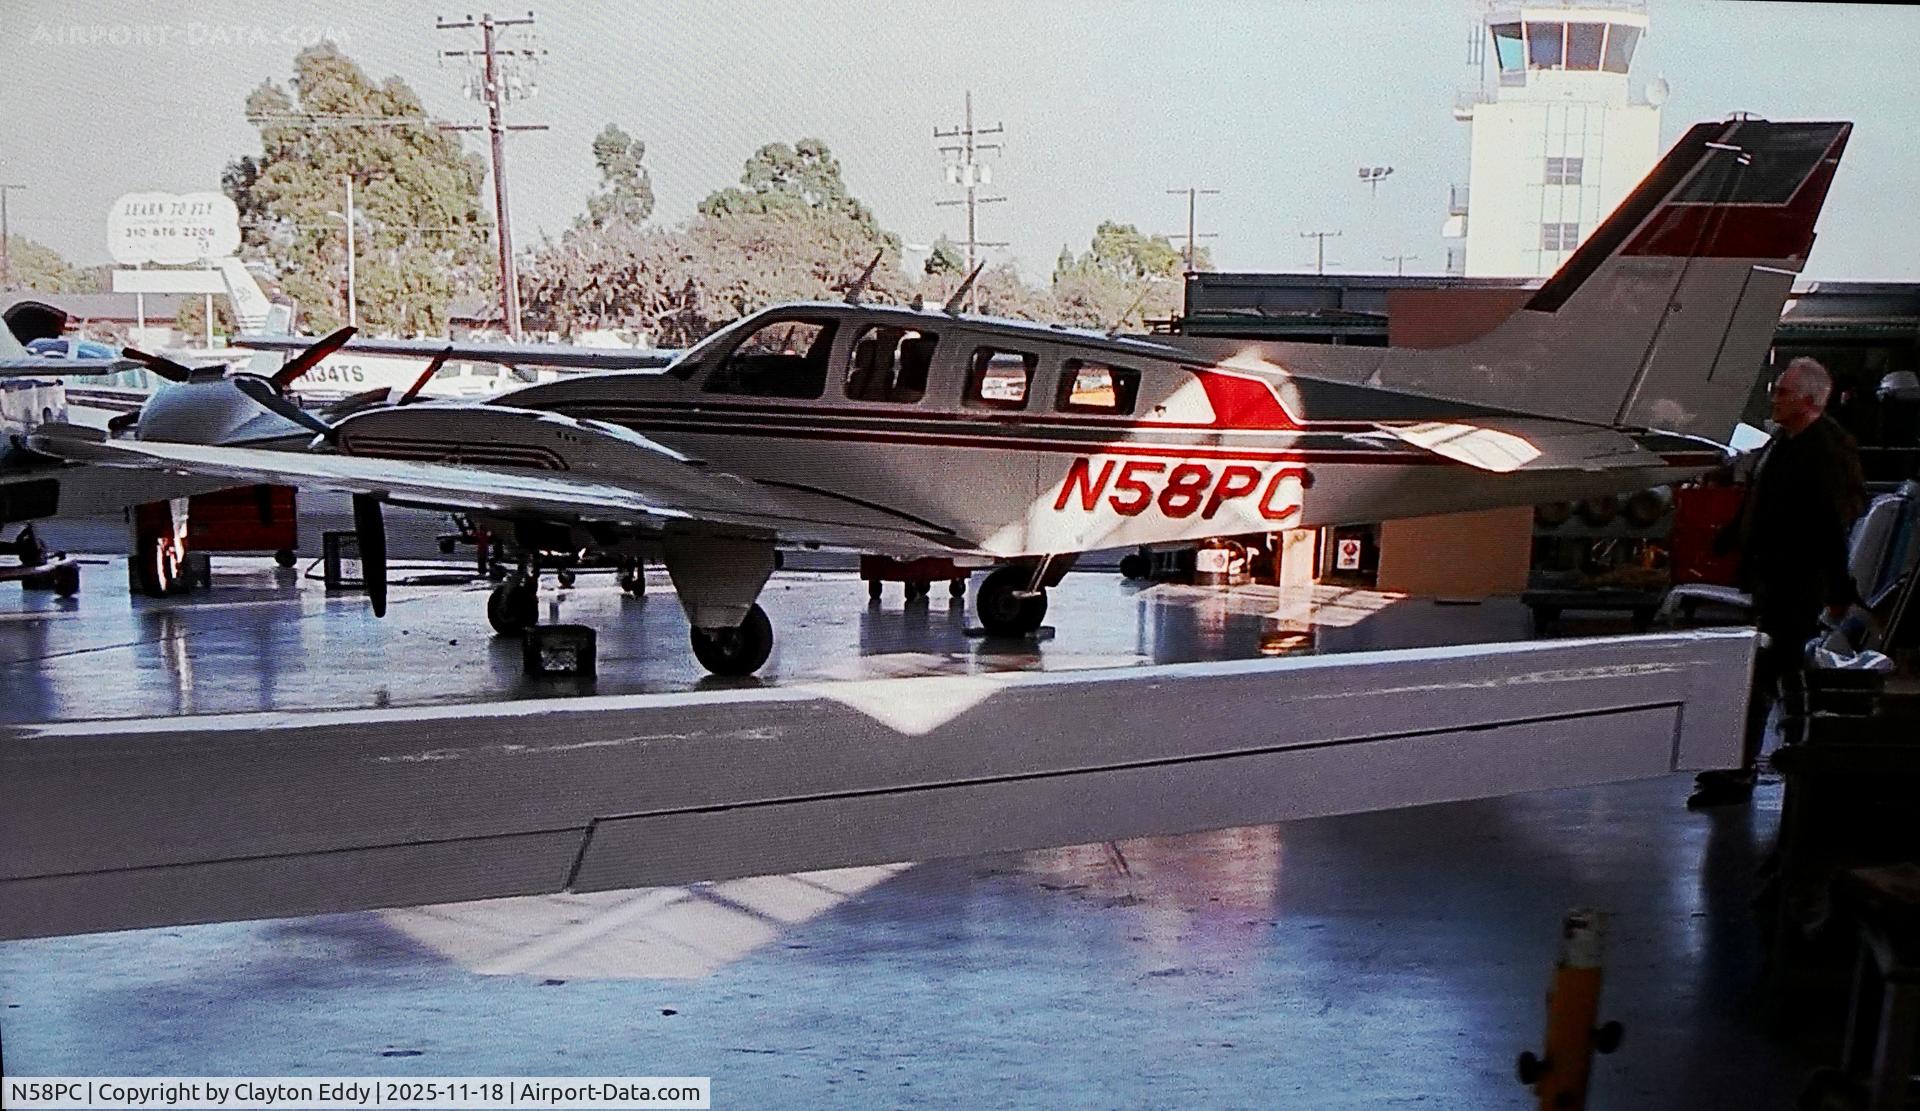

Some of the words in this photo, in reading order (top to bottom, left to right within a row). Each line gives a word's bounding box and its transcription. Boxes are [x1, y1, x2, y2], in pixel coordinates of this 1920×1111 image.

[124, 202, 165, 216] LEARN
[171, 202, 187, 216] TO
[191, 202, 213, 216] FLY
[1053, 456, 1316, 521] N58PC
